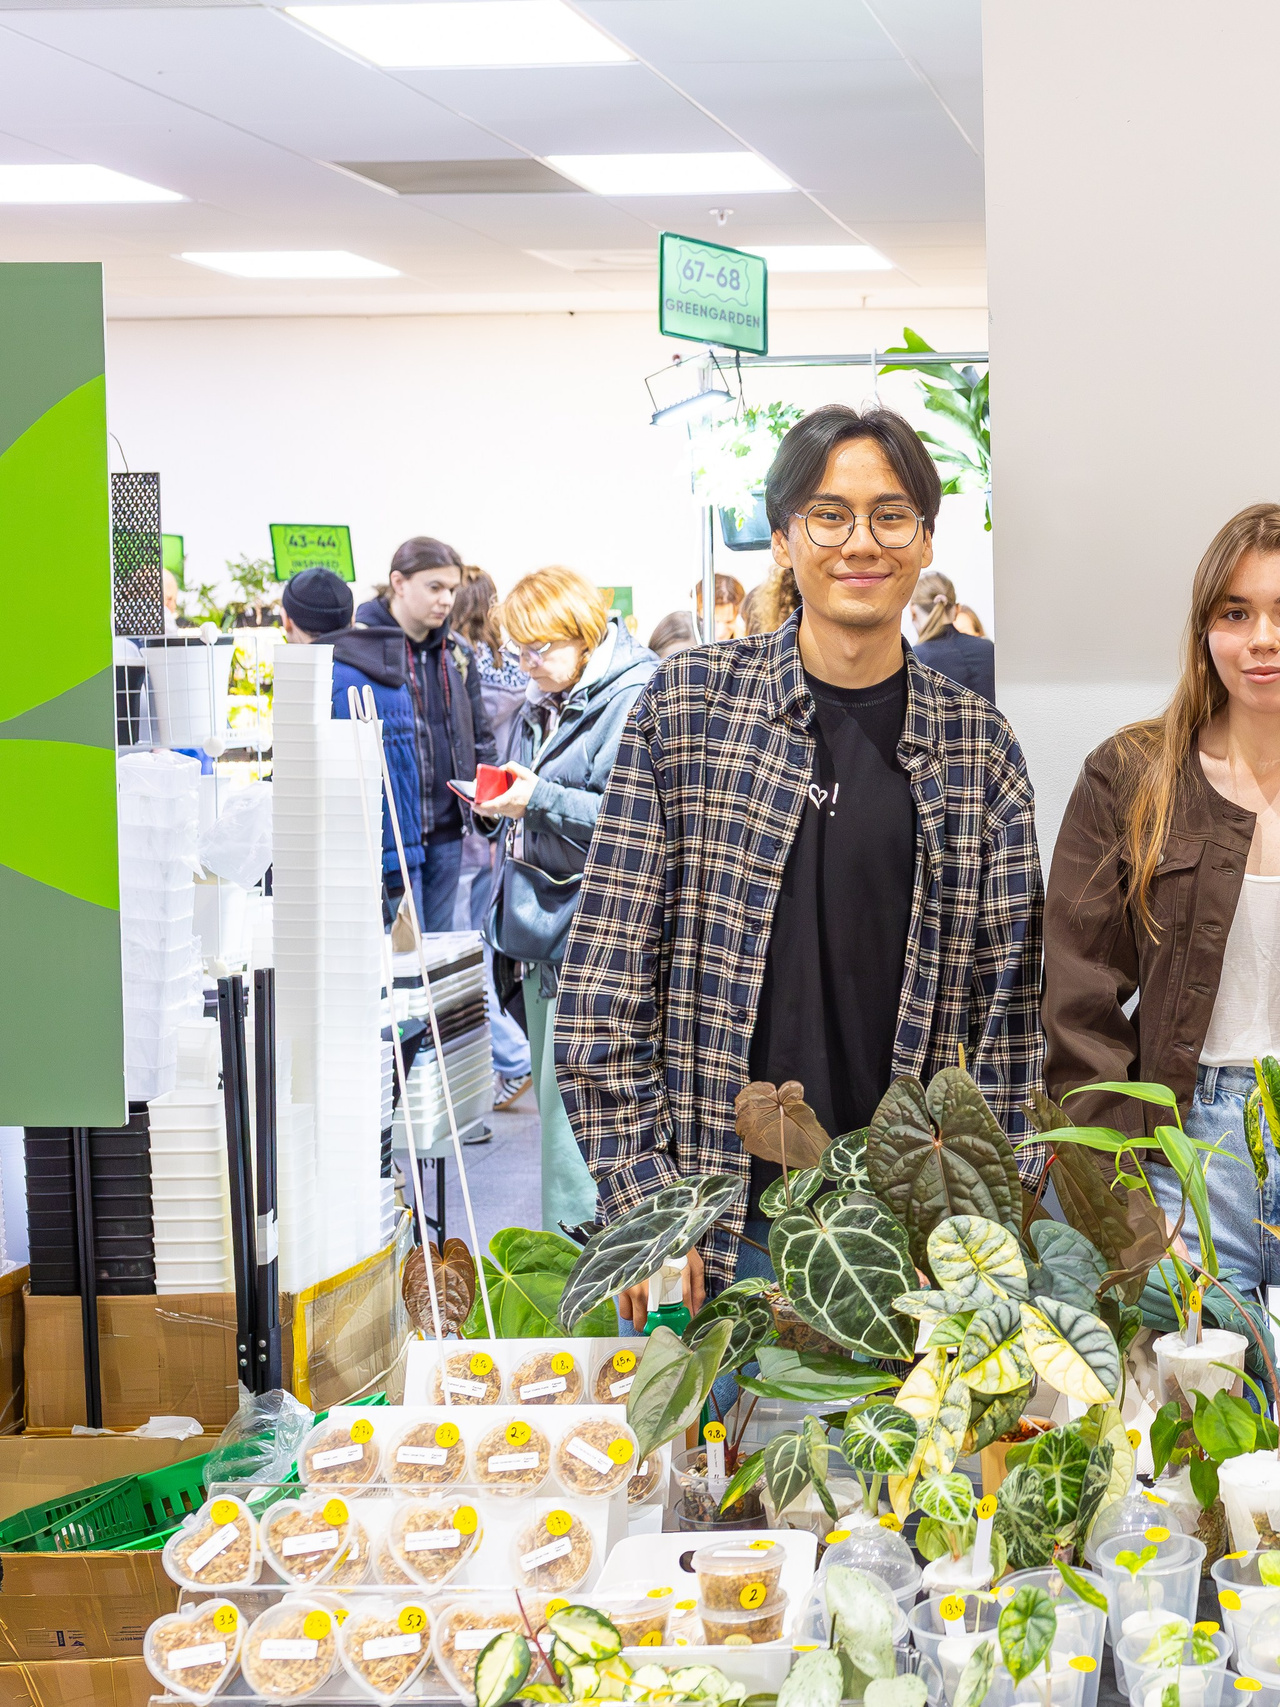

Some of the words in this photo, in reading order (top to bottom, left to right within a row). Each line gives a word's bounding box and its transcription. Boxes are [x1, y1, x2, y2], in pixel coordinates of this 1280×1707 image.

[682, 258, 741, 291] 67-68
[665, 298, 760, 328] GREENGARDEN
[289, 534, 336, 548] 43-44
